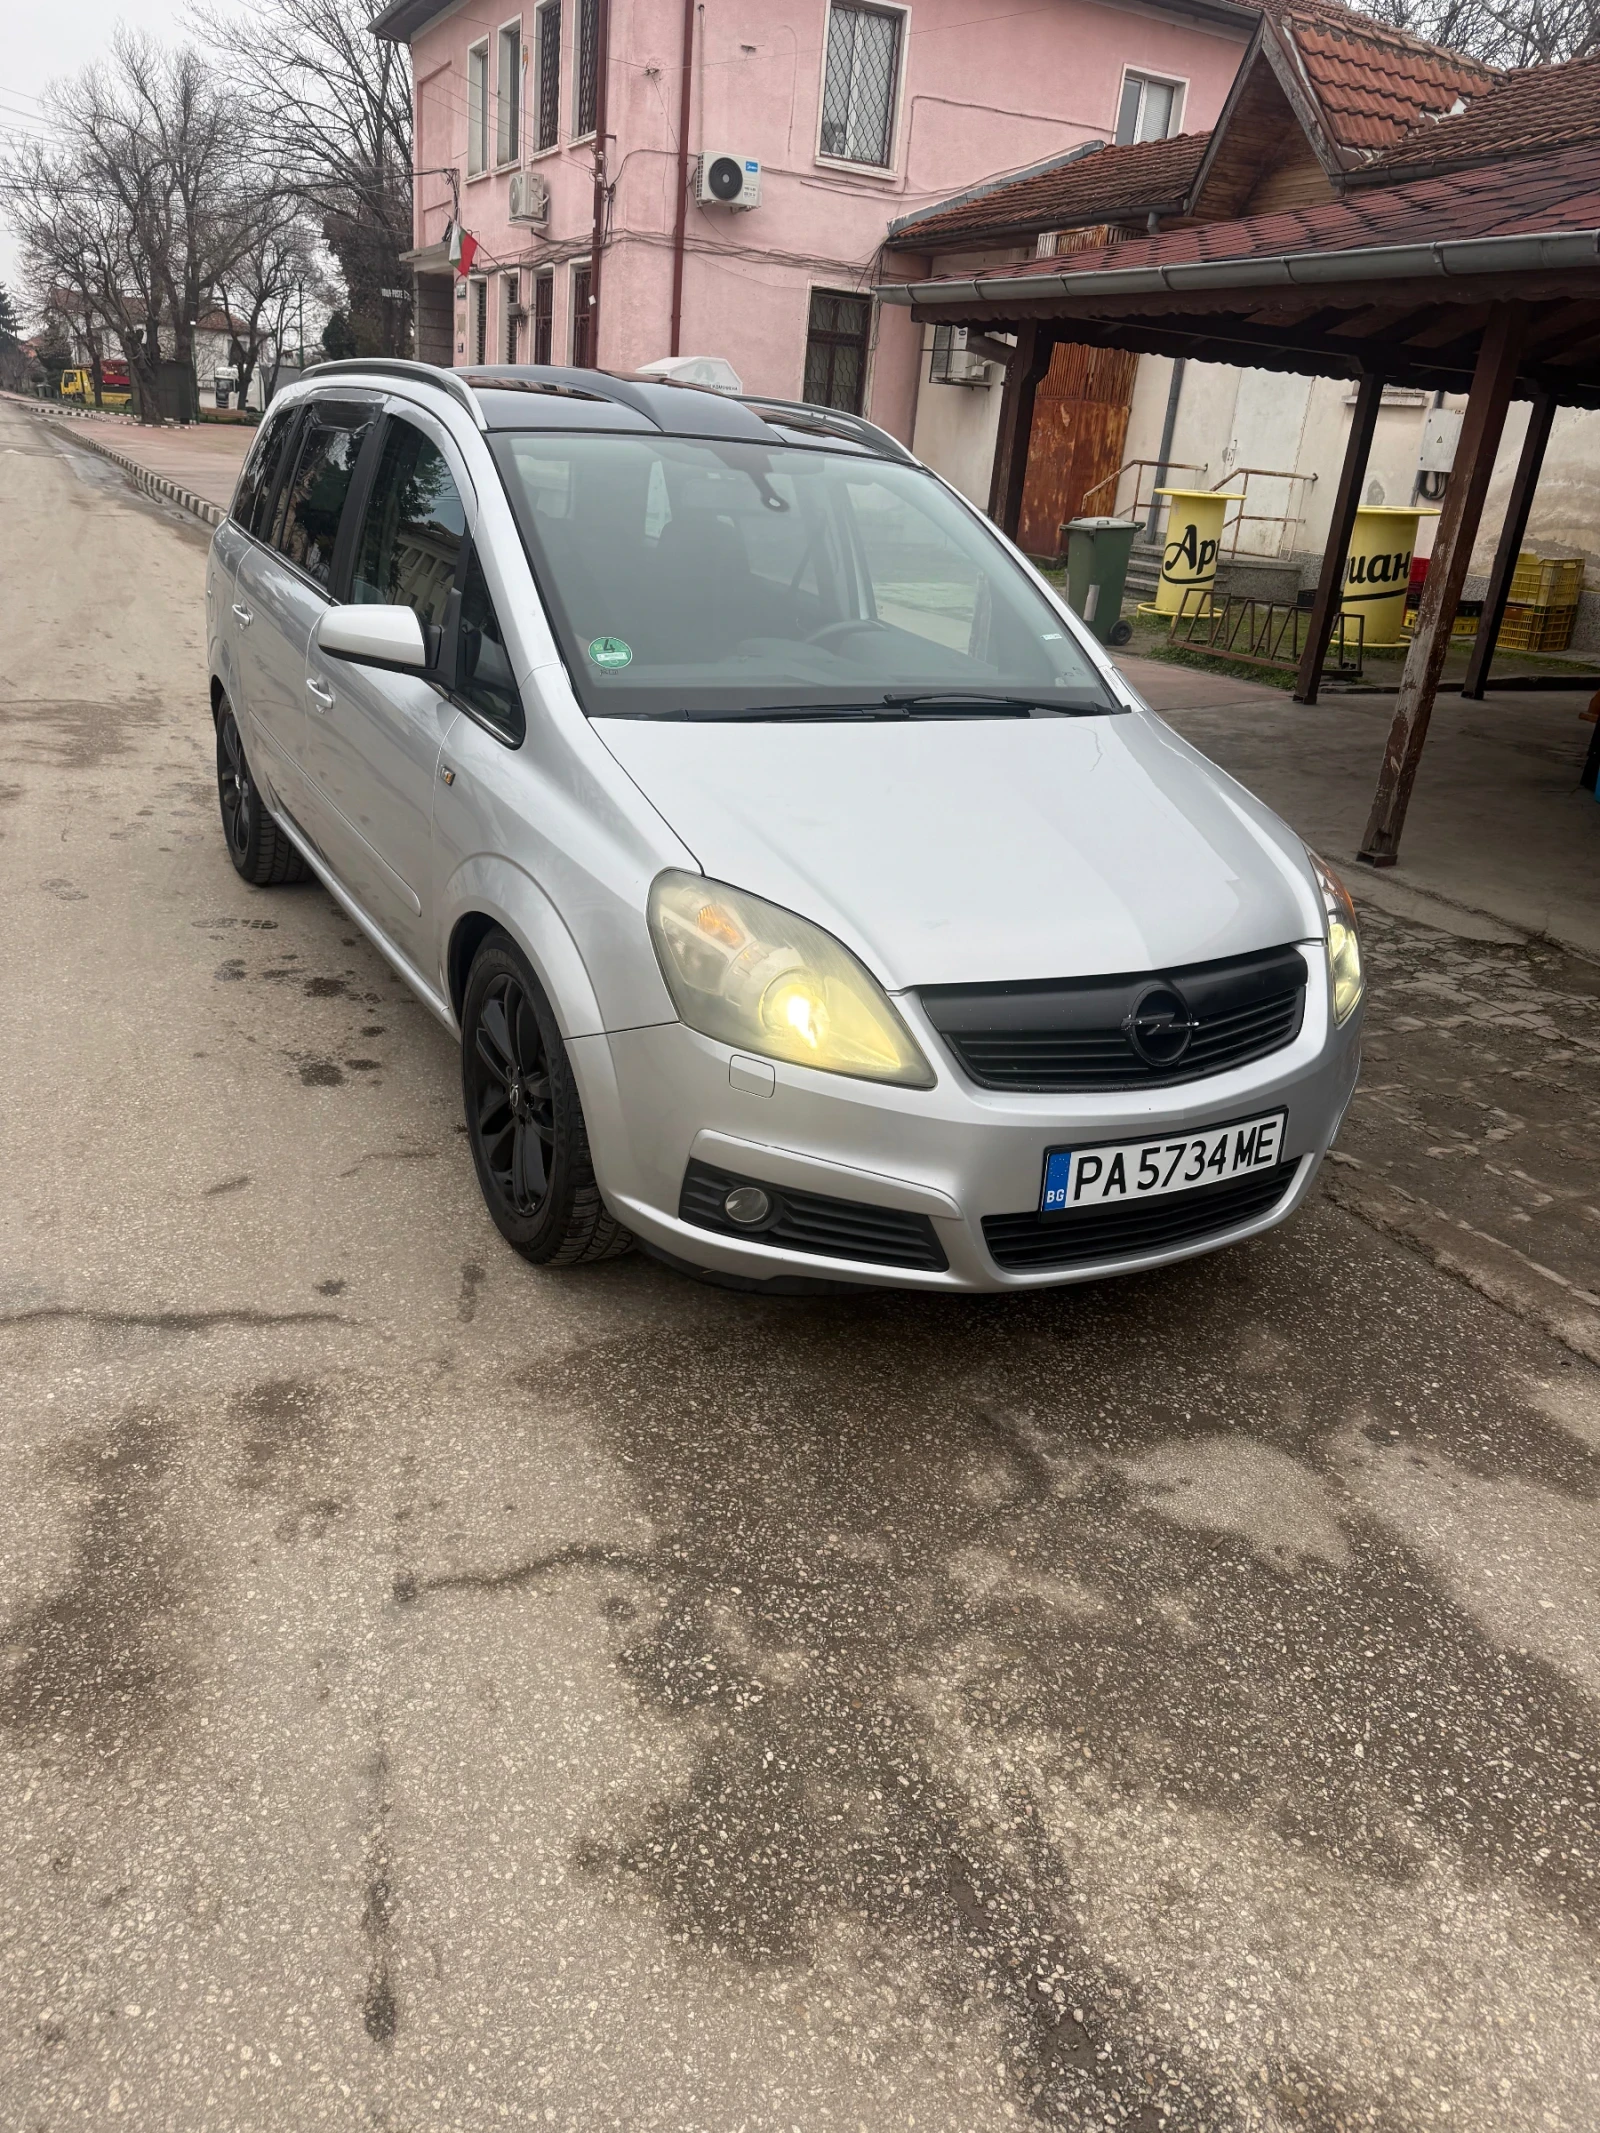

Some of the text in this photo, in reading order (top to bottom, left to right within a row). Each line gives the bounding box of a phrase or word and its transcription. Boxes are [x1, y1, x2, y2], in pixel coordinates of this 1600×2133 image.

[603, 638, 616, 653] 4
[1073, 1121, 1278, 1201] PA 5734 ME
[1046, 1188, 1065, 1204] BG
